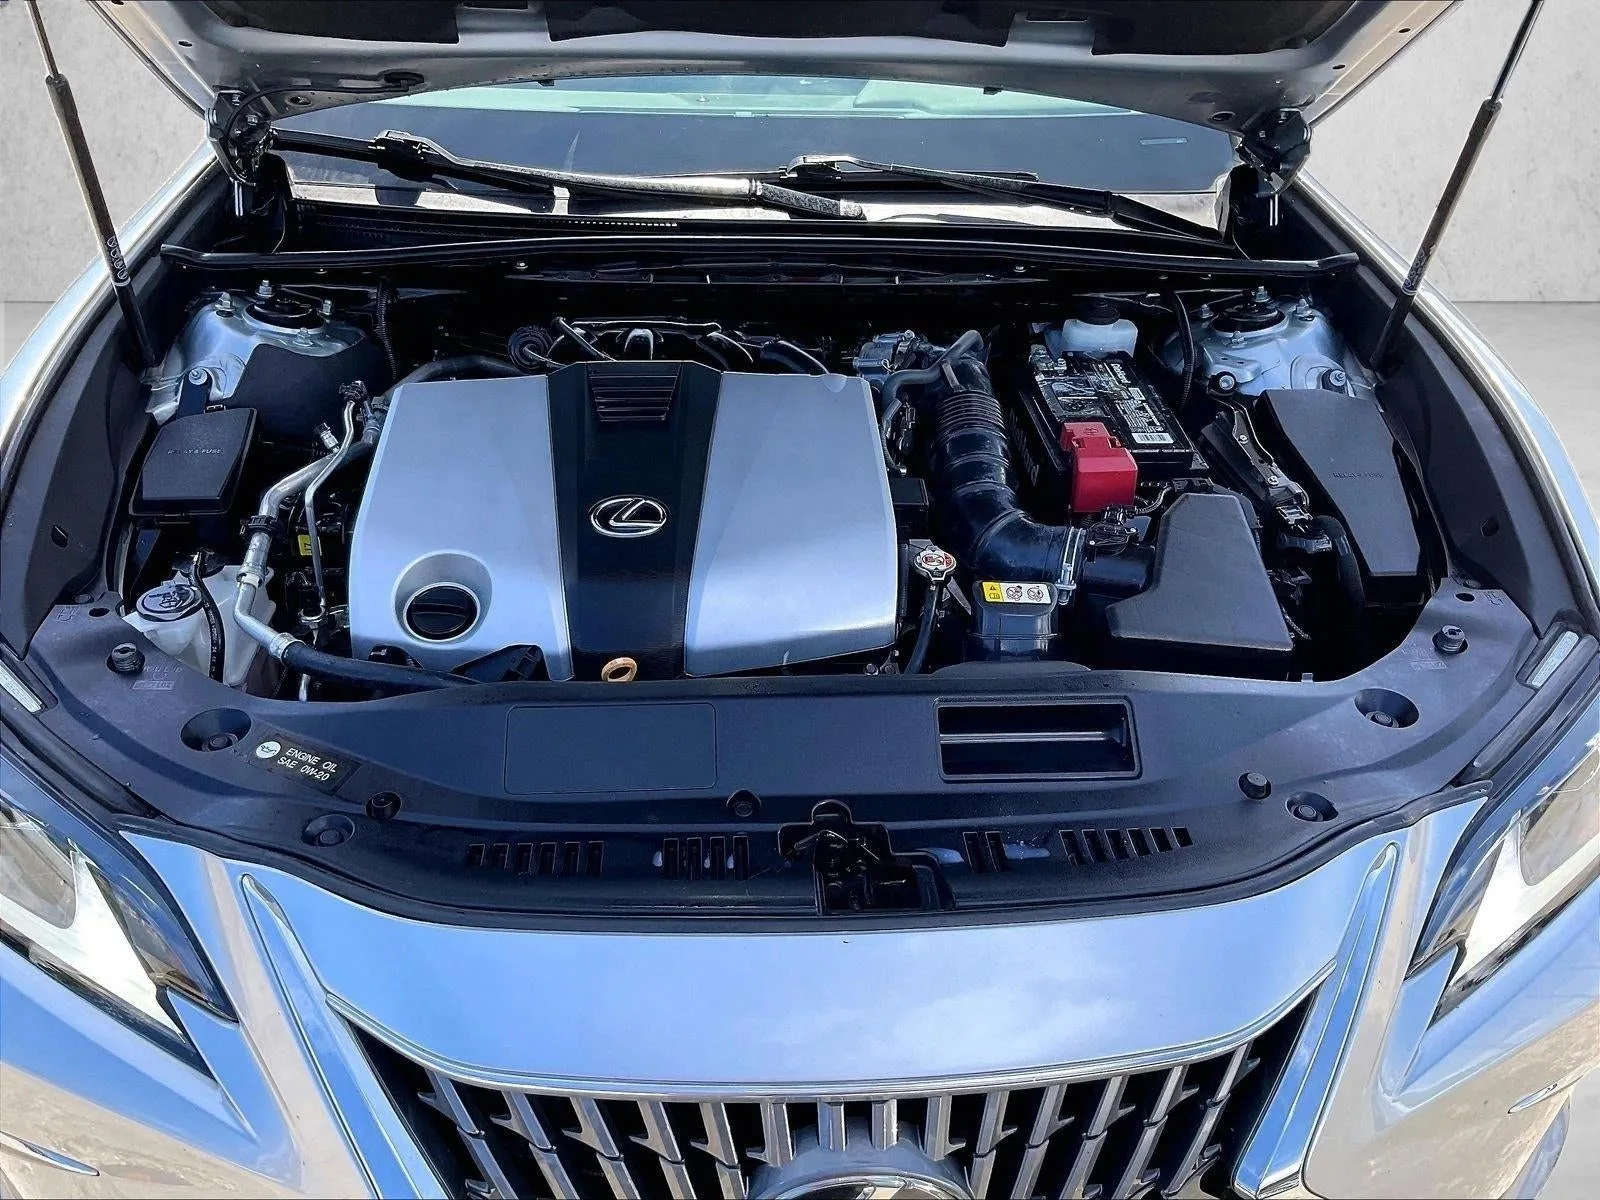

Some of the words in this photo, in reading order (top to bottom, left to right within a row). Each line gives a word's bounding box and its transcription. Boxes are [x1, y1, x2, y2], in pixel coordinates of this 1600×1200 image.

[277, 756, 299, 769] SAE
[300, 764, 330, 781] 0W-20
[285, 747, 321, 766] ENGINE
[322, 761, 338, 773] OIL
